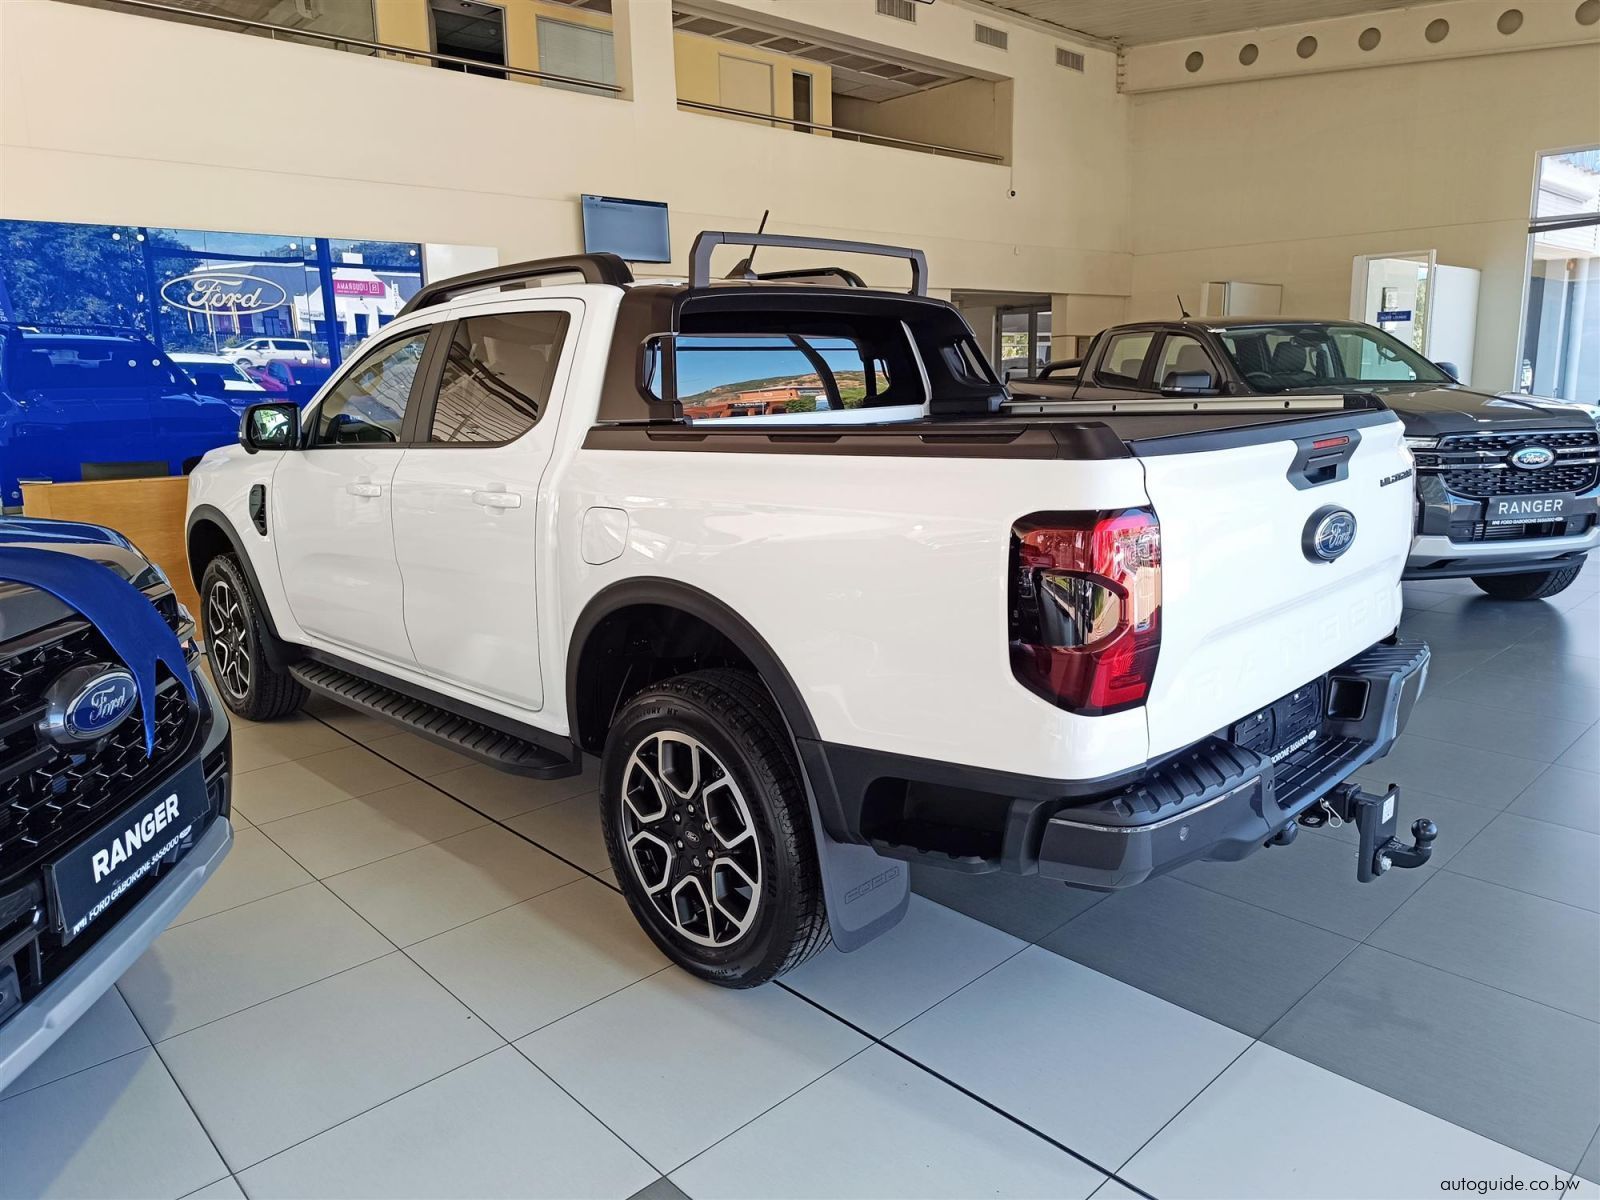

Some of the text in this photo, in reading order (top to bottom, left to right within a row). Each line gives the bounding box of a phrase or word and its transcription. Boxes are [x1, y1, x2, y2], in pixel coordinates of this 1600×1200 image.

[187, 279, 262, 307] Ford
[1498, 499, 1563, 514] RANGER
[1329, 522, 1350, 548] Ford
[90, 685, 127, 725] Ford
[92, 793, 180, 884] RANGER
[88, 895, 110, 920] FORD
[110, 860, 151, 900] GABORONE
